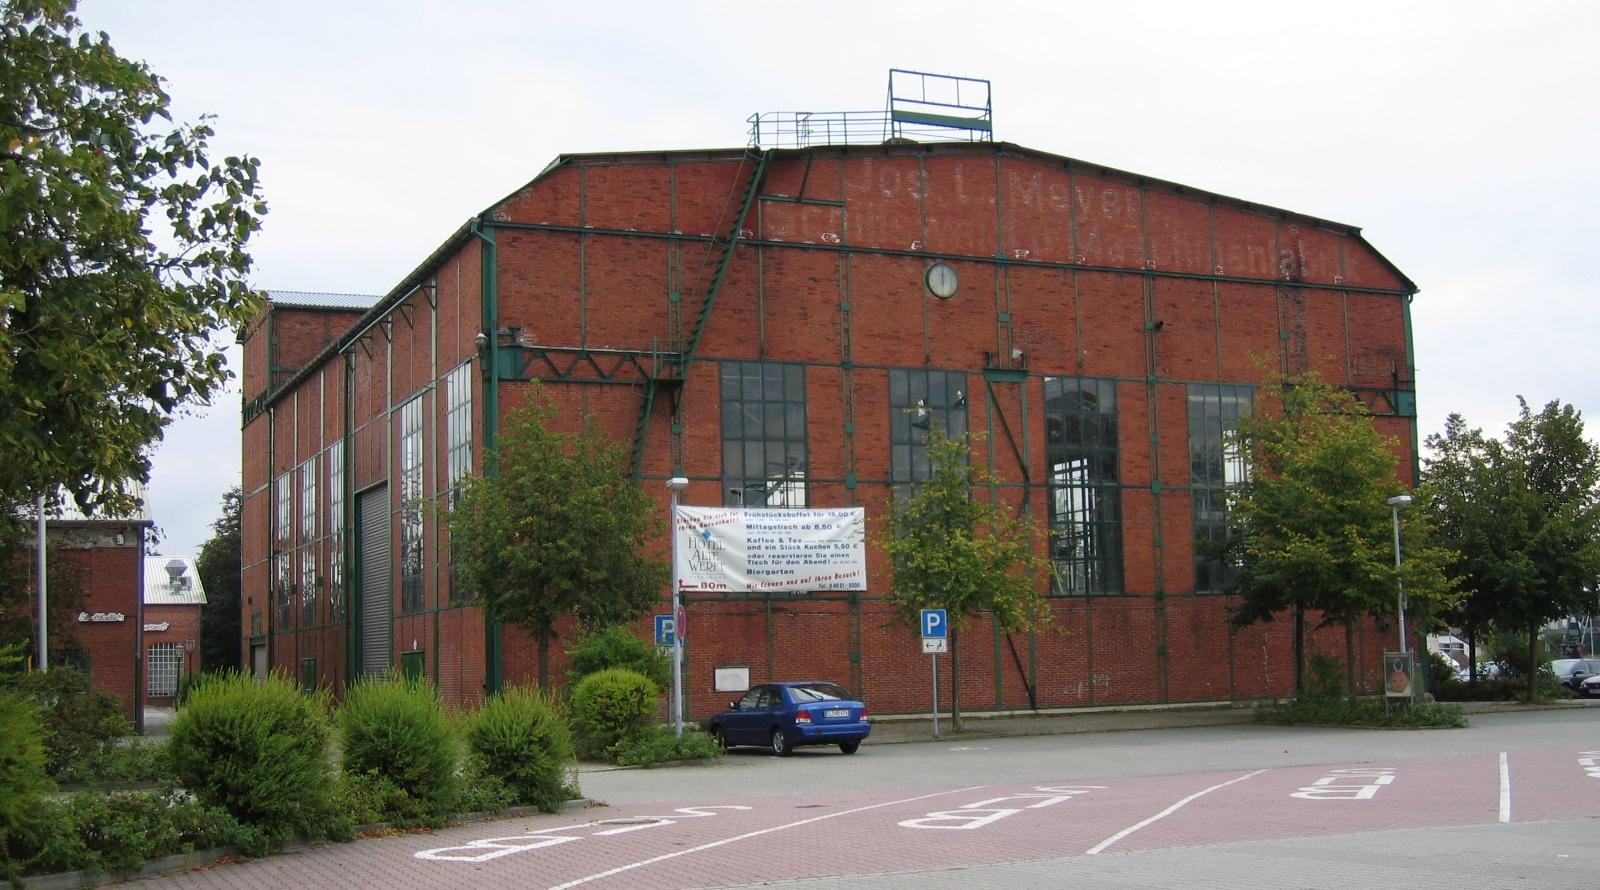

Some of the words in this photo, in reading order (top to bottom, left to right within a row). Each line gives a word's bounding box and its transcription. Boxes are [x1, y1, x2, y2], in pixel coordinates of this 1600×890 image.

[661, 619, 675, 642] P
[927, 613, 941, 635] P
[1290, 767, 1397, 800] BUS
[897, 785, 1108, 829] BUS
[414, 805, 753, 862] BUS
